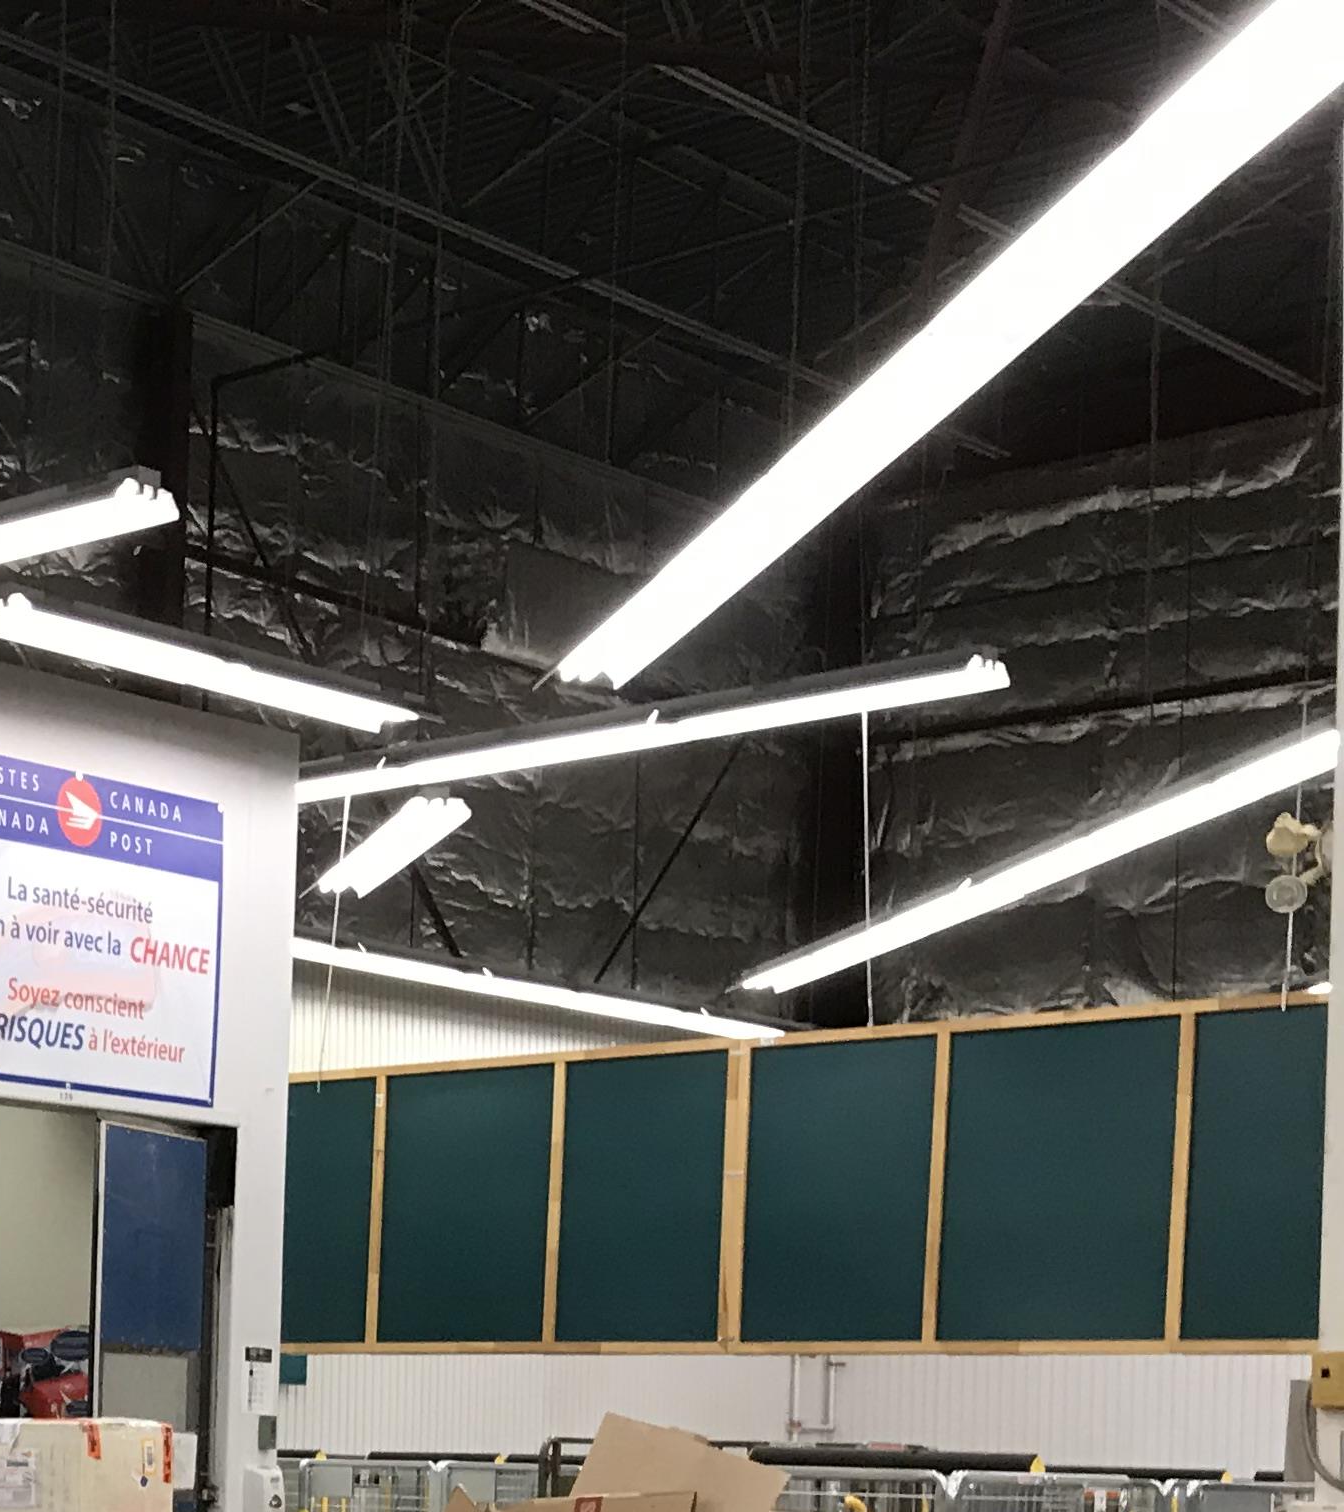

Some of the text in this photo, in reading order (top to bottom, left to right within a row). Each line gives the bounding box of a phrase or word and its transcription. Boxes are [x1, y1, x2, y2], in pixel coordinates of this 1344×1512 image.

[109, 791, 183, 823] CANADA
[110, 831, 154, 856] POST
[7, 875, 154, 924] La santé-sécurité
[10, 915, 21, 940] à
[25, 921, 60, 945] voir
[63, 929, 103, 954] avec
[107, 933, 122, 956] la
[130, 936, 211, 975] CHANCE
[7, 977, 146, 1020] Soyez conscient
[88, 1026, 99, 1052] à
[102, 1028, 186, 1063] l'extérieur
